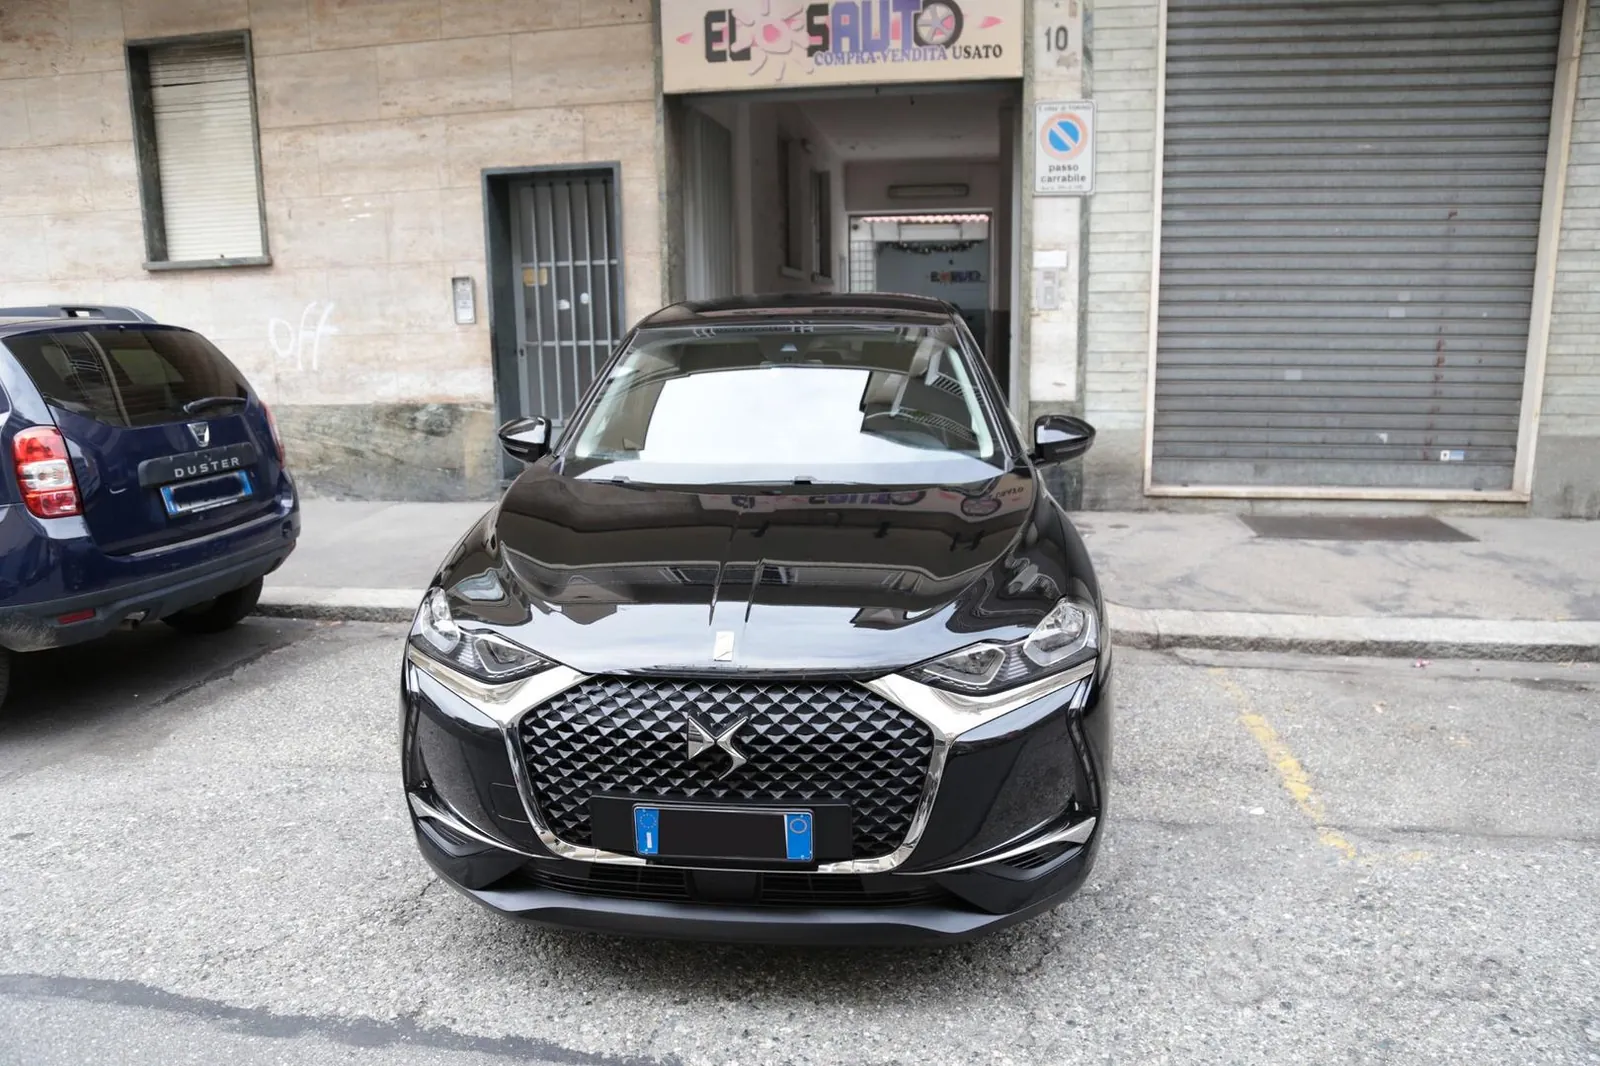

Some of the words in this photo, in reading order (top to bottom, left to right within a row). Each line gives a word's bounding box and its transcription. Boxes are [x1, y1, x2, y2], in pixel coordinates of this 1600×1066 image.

[704, 8, 751, 63] EL
[1044, 25, 1068, 52] 10
[951, 43, 1003, 60] USATO
[1048, 164, 1079, 173] passo
[1040, 174, 1087, 183] carrabile
[174, 457, 241, 478] DUSTER
